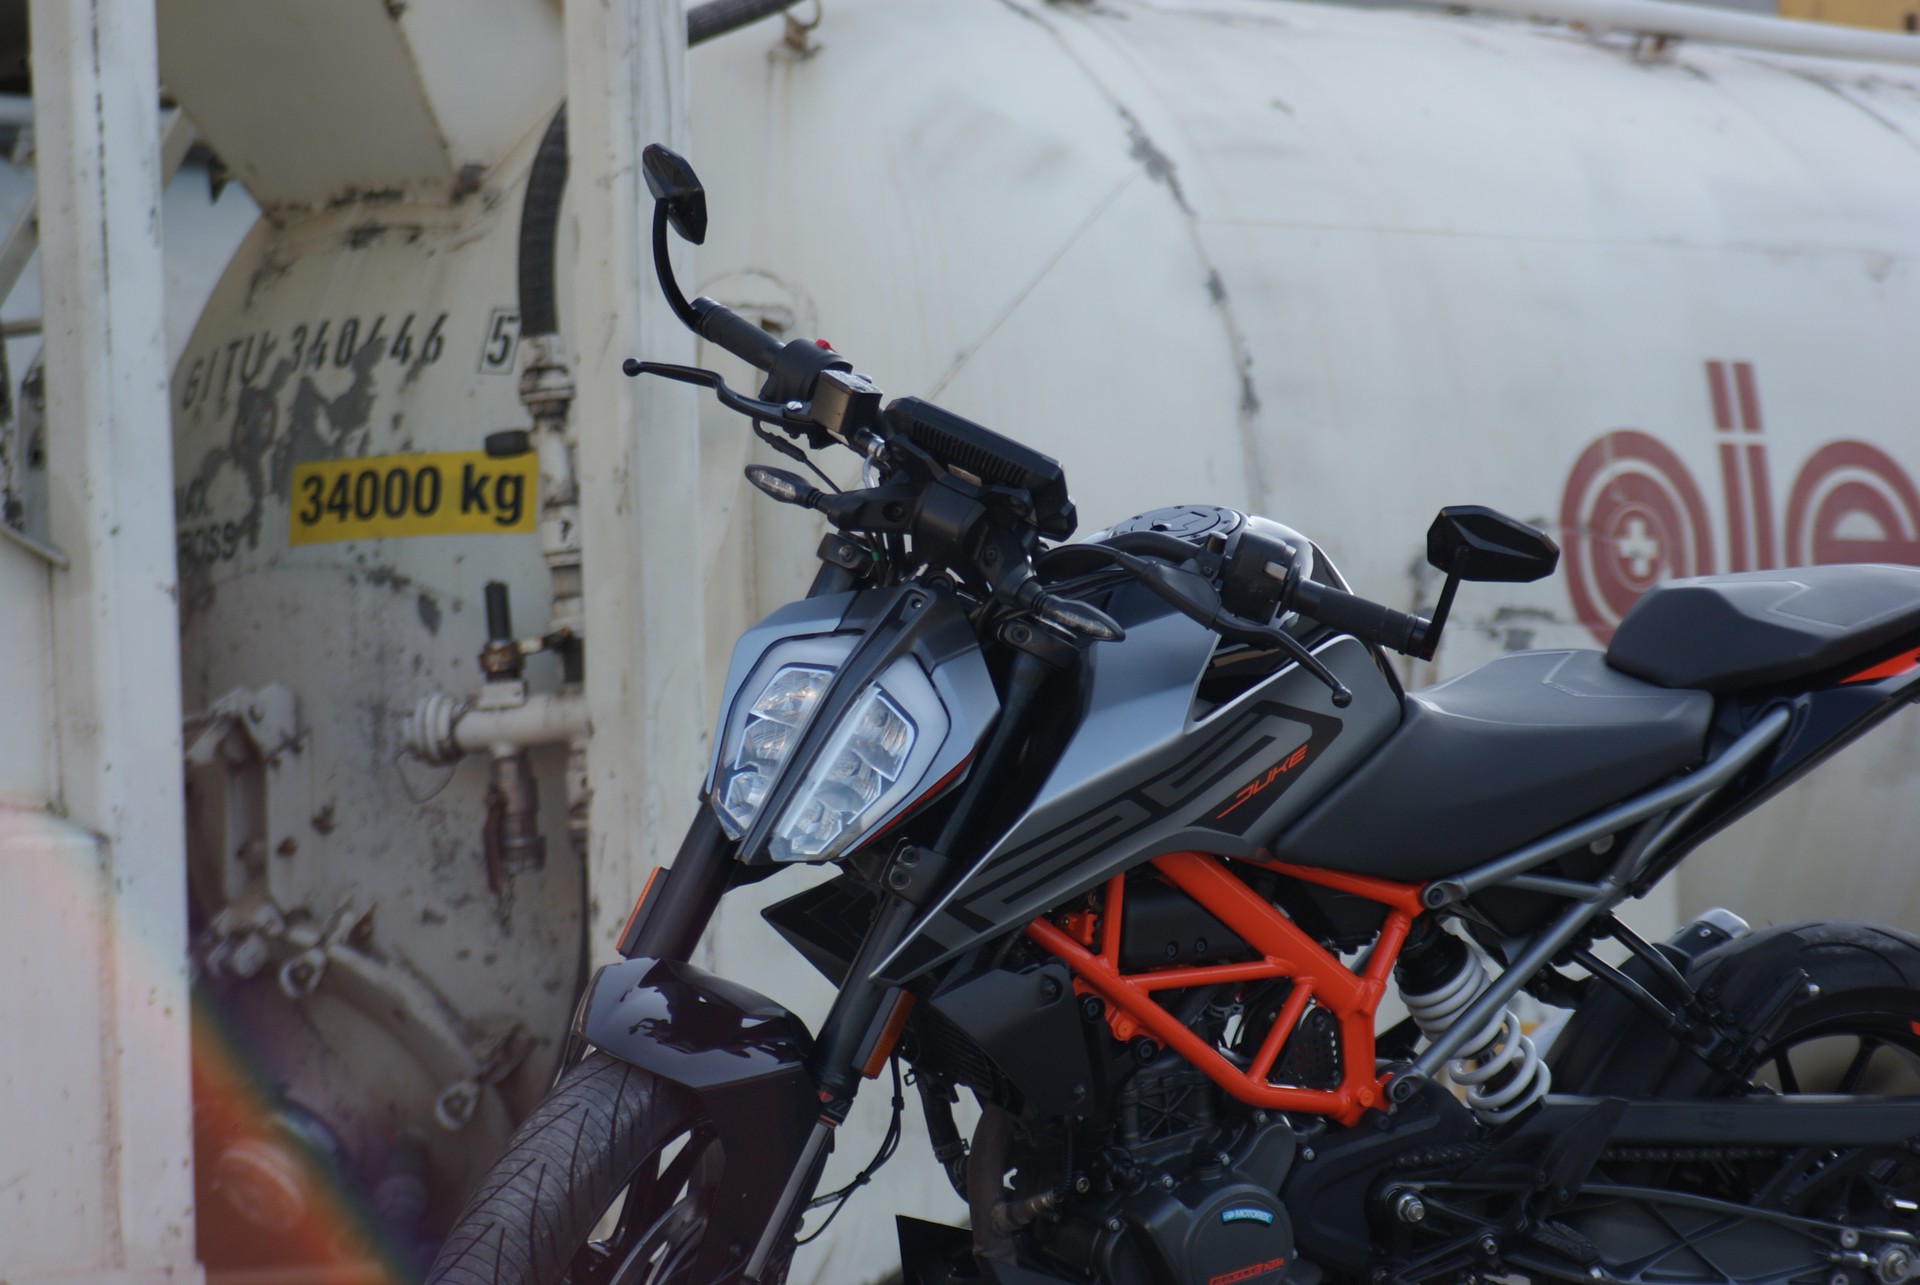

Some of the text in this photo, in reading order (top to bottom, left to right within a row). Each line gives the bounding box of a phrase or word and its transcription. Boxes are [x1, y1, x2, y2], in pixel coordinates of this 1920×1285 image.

[486, 316, 519, 365] 5
[301, 464, 524, 526] 34000 kg
[1217, 745, 1308, 819] DUKE
